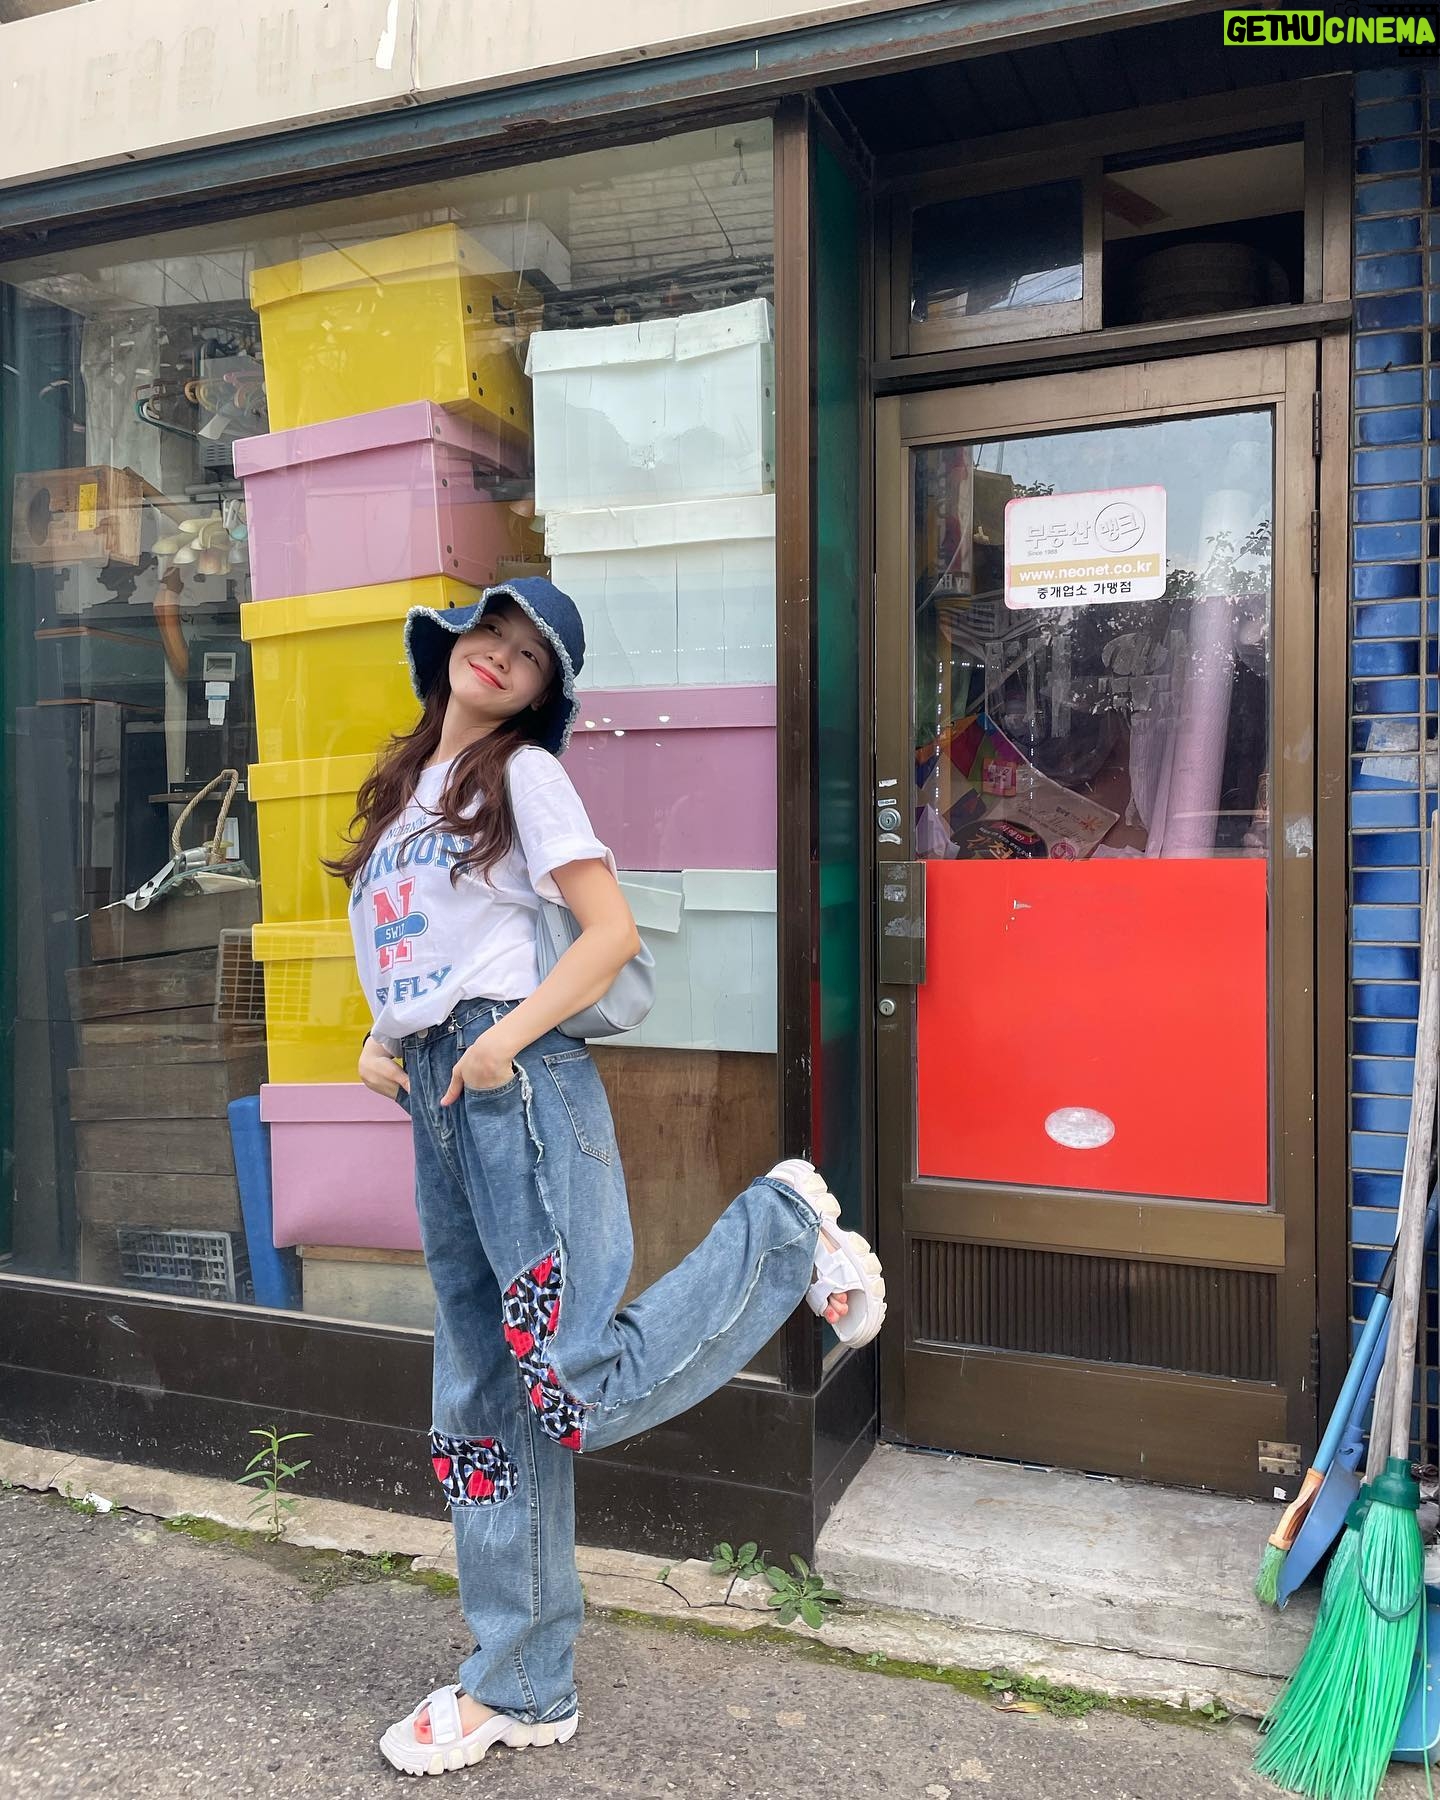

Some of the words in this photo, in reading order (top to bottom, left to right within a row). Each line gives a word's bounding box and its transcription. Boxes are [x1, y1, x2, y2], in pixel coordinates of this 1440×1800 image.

[1026, 520, 1091, 549] 부동산
[1100, 513, 1140, 541] 뱅크
[1019, 561, 1152, 582] www.neonet.co.kr
[1037, 585, 1088, 600] 중개업소
[1093, 581, 1132, 595] 가맹점
